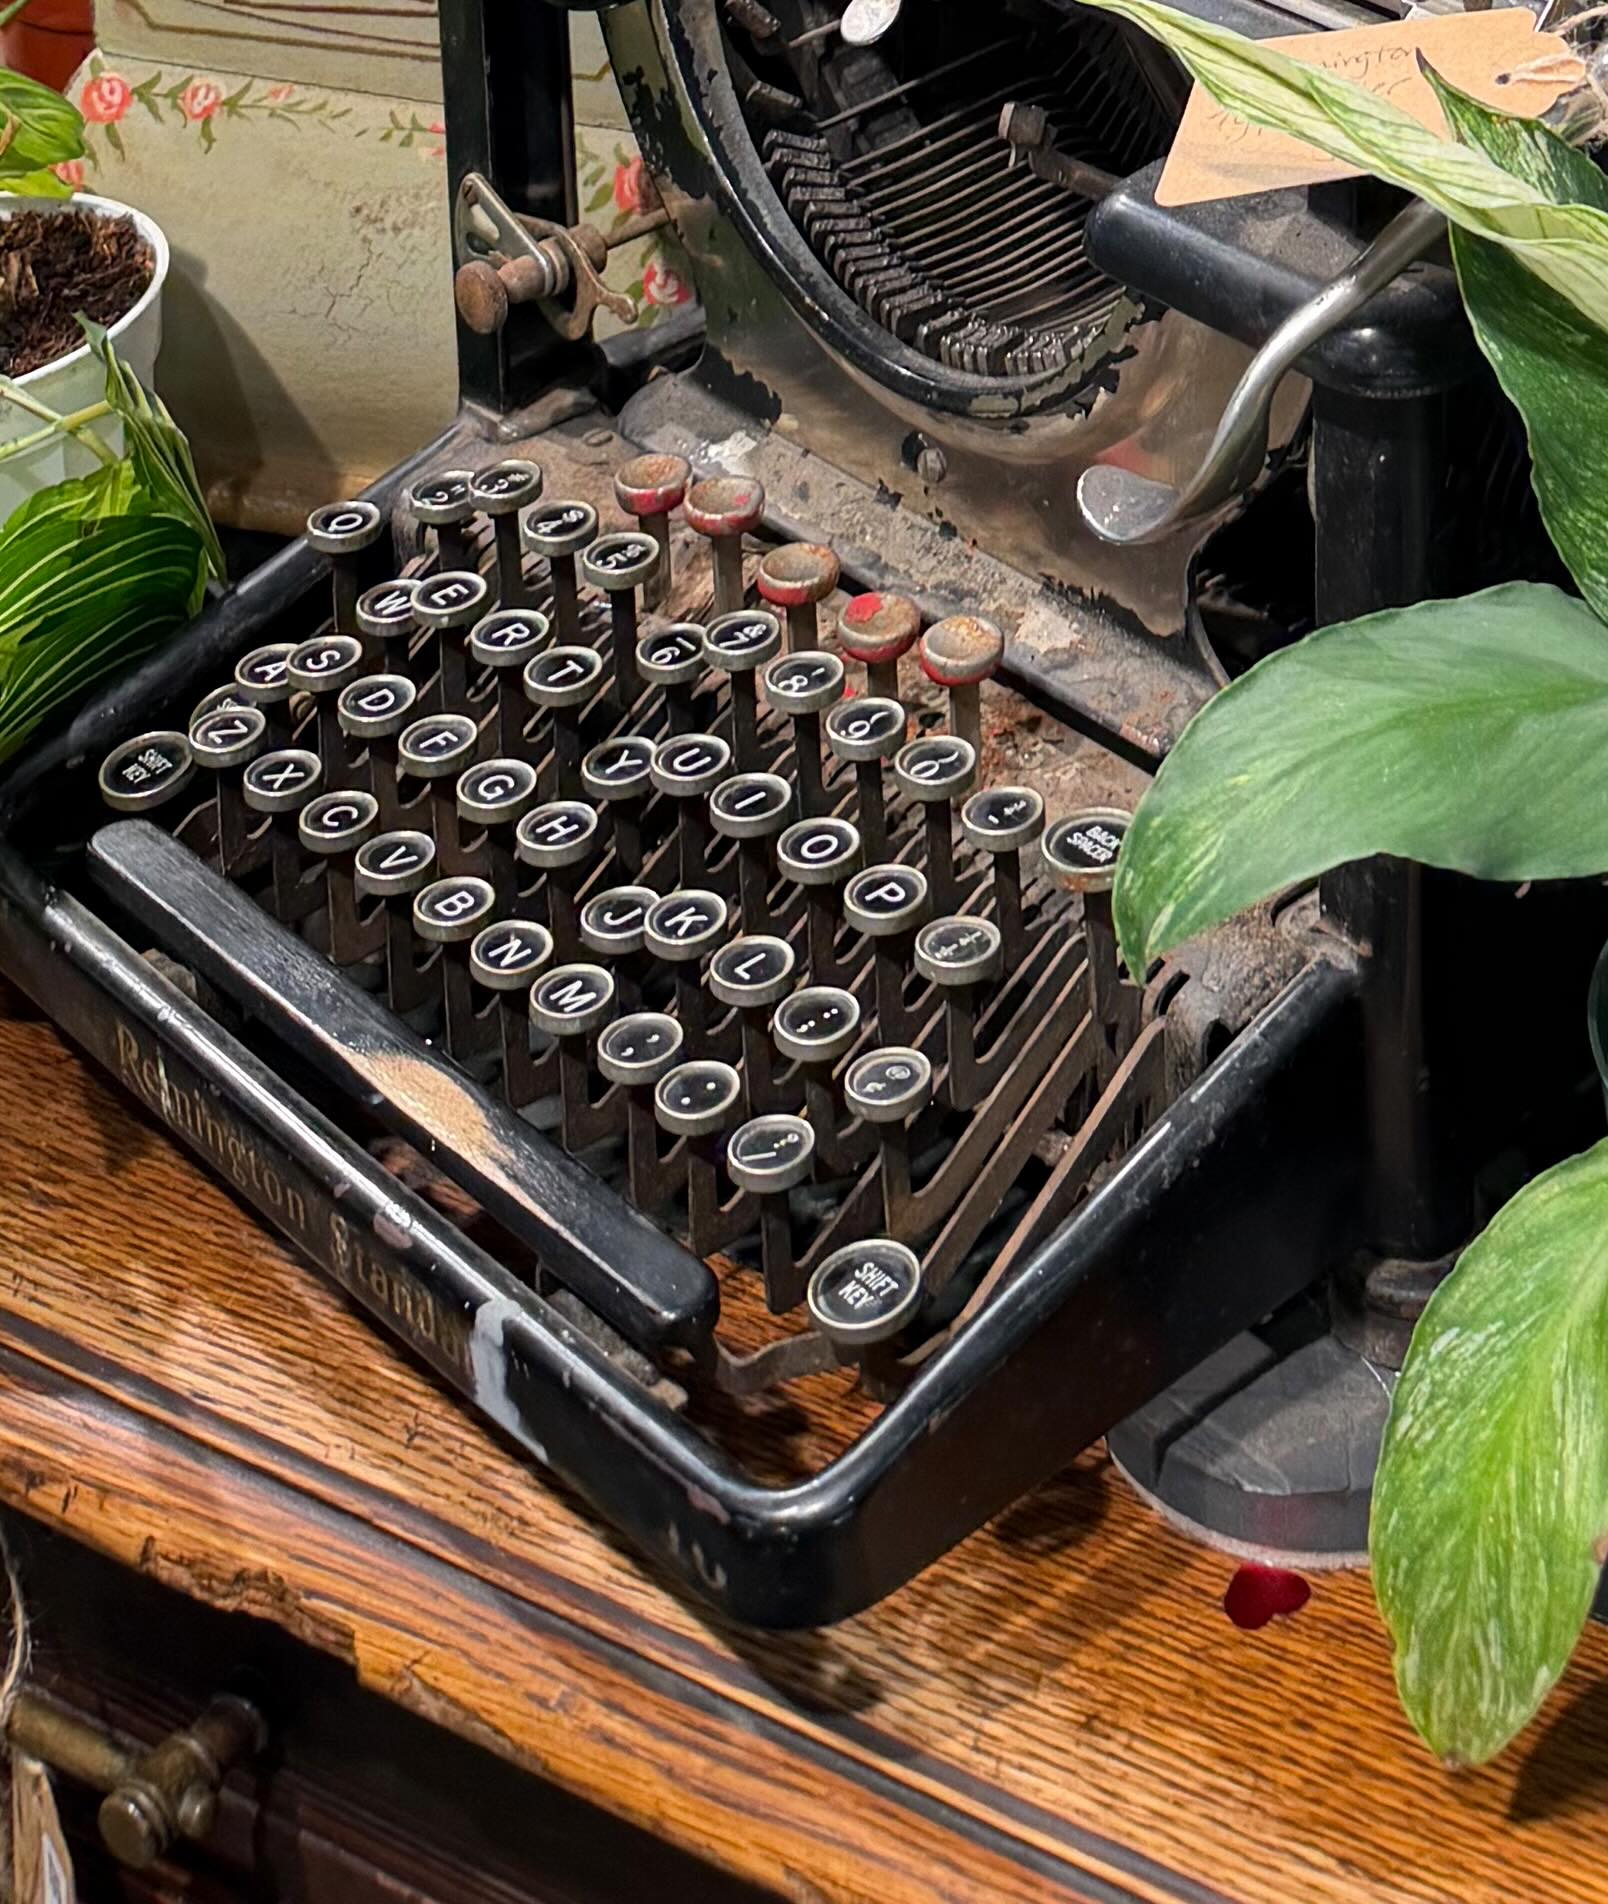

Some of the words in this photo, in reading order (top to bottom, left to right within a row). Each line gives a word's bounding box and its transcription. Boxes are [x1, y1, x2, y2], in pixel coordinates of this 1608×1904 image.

[327, 512, 364, 533] Q
[373, 589, 412, 616] W
[430, 582, 470, 606] E
[490, 622, 531, 647] R
[253, 660, 287, 682] A
[305, 649, 341, 671] S
[546, 659, 584, 682] T
[357, 688, 396, 712] D
[207, 719, 249, 744] Z
[418, 729, 459, 750] F
[138, 748, 173, 775] SHIFT
[604, 748, 643, 775] Y
[672, 747, 712, 772] U
[121, 763, 151, 784] KEY
[261, 762, 305, 790] X
[477, 773, 516, 802] G
[321, 804, 359, 828] C
[535, 815, 580, 843] H
[378, 845, 419, 870] V
[800, 833, 839, 859] O
[433, 890, 476, 917] B
[864, 880, 907, 903] P
[602, 906, 643, 927] J
[664, 905, 709, 937] K
[488, 937, 533, 968] N
[733, 952, 767, 981] L
[549, 979, 597, 1014] M
[114, 1023, 307, 1232] Remington
[854, 1261, 899, 1297] SHIFT
[838, 1279, 875, 1310] KEY
